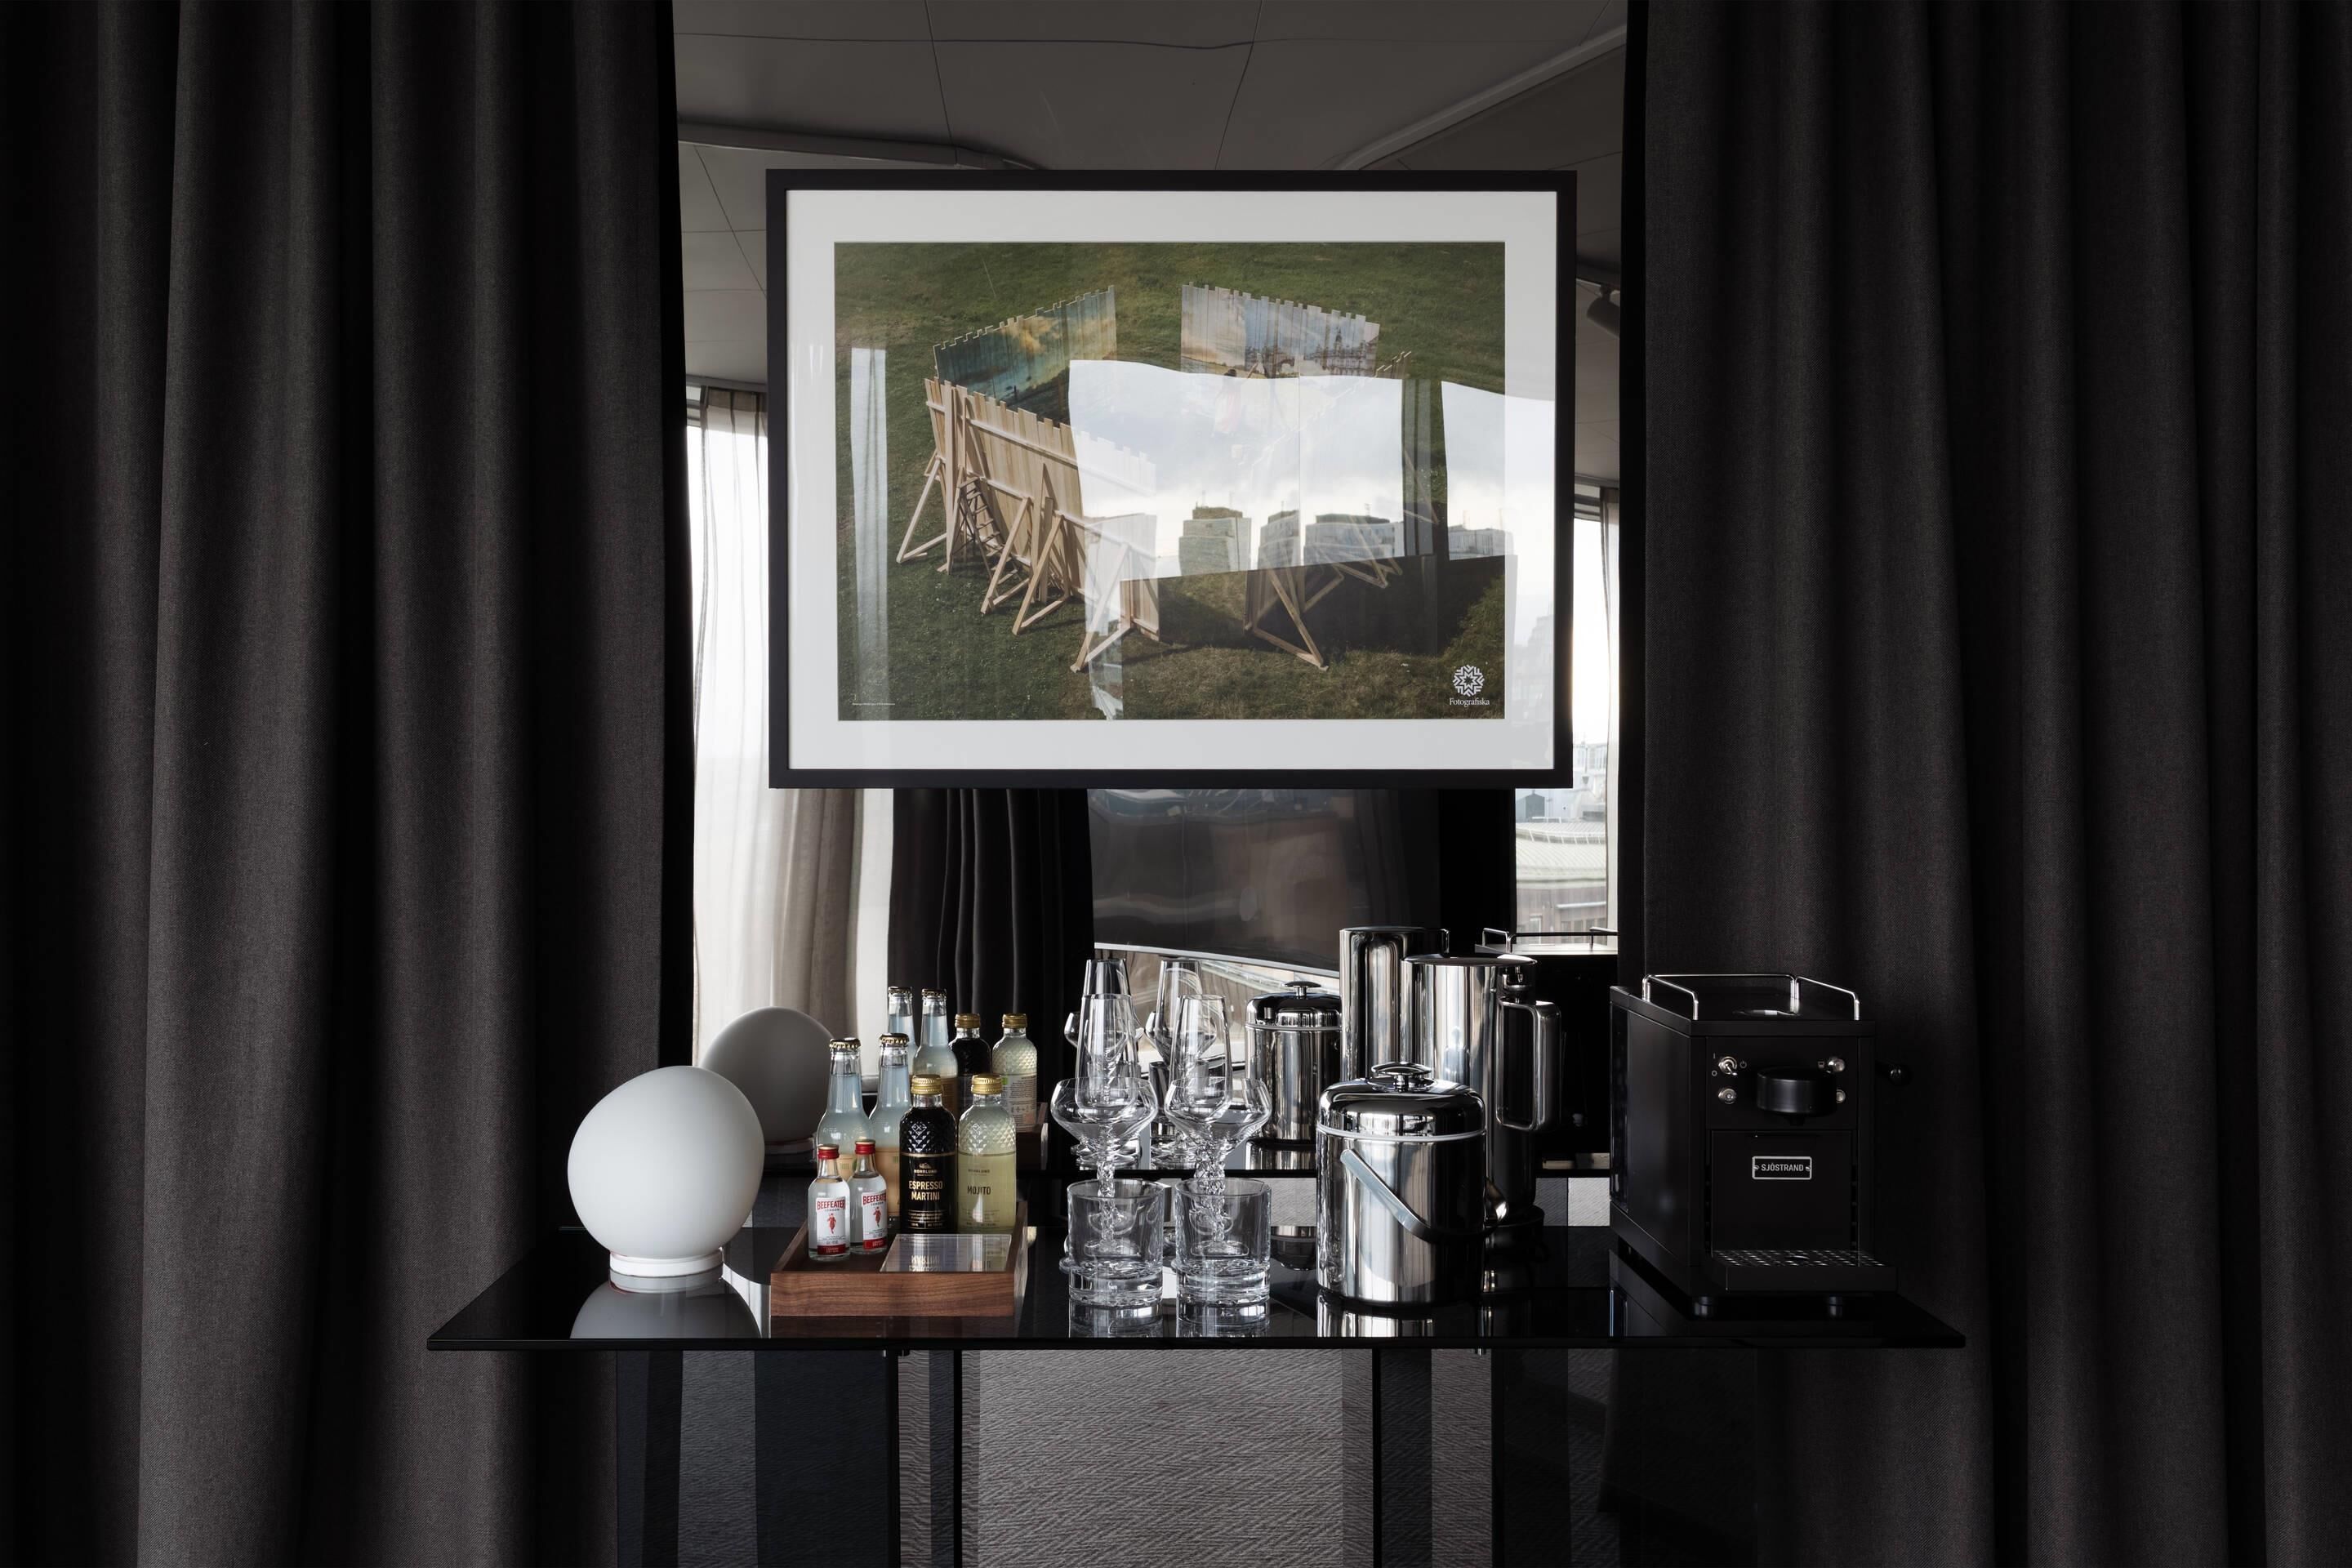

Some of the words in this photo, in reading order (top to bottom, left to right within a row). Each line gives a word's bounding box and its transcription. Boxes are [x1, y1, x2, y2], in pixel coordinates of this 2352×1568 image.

[1449, 697, 1490, 707] Fotografiska
[908, 1181, 942, 1190] ESPRESSO
[967, 1186, 991, 1195] MOJITO
[863, 1194, 887, 1205] BEEFEATE
[911, 1192, 940, 1200] MARTINI
[817, 1200, 846, 1210] BEEFEATER
